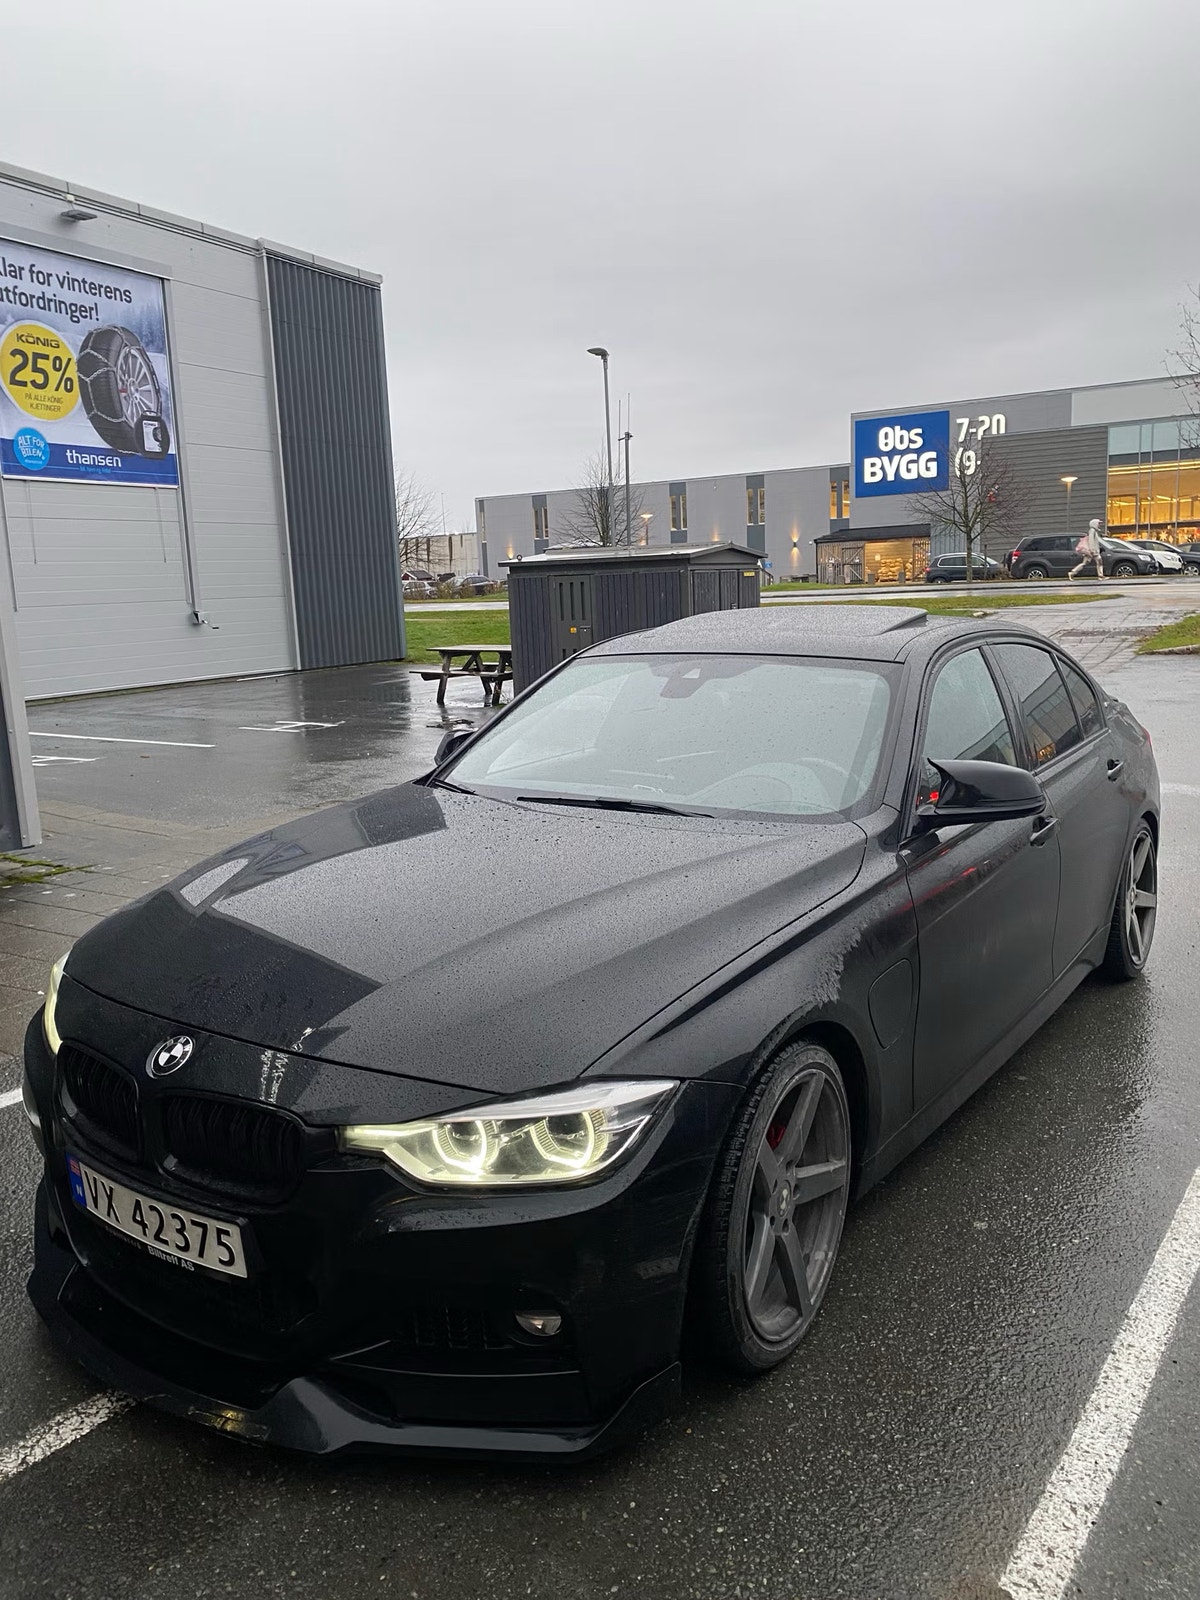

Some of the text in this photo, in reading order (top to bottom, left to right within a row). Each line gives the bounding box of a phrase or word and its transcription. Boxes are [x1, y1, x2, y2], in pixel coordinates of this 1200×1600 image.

[29, 263, 53, 287] for
[55, 270, 132, 304] vinterens
[16, 333, 60, 349] KÖNIG
[9, 348, 74, 393] 25%
[18, 435, 45, 449] ALT FOR
[66, 449, 121, 468] thansen
[863, 451, 938, 484] BYGG
[84, 1170, 121, 1224] VX
[132, 1199, 236, 1267] 42375
[180, 1258, 195, 1271] AS
